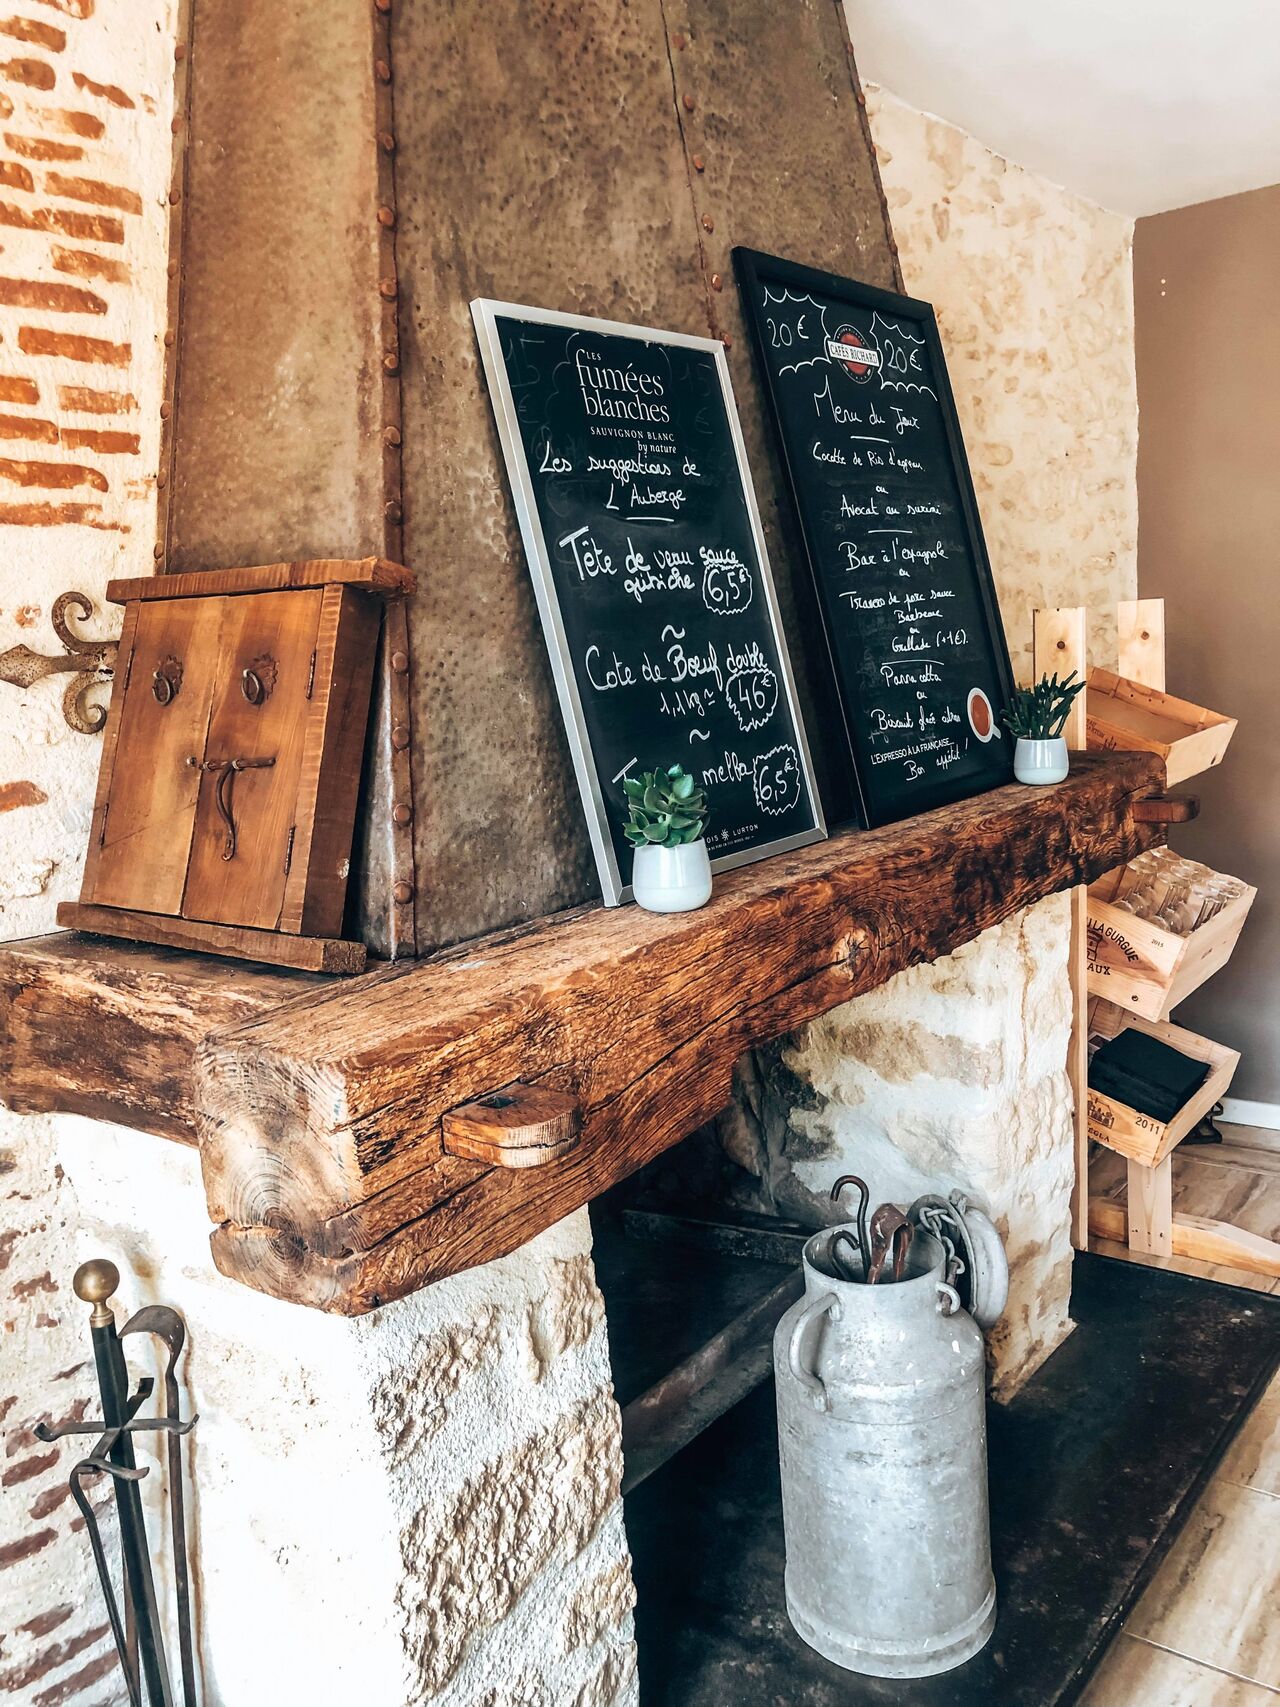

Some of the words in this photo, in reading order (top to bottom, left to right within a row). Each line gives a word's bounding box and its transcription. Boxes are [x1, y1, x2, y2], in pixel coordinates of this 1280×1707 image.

[586, 351, 602, 361] LES
[850, 348, 878, 364] RICHARD
[576, 348, 664, 396] fumées
[581, 387, 670, 423] blanches
[813, 374, 863, 424] Menu
[869, 402, 886, 425] du
[890, 406, 921, 435] Jour
[590, 426, 644, 439] SAUVIGNON
[647, 431, 676, 442] BLANC
[637, 440, 648, 454] by
[650, 443, 677, 454] nature
[539, 440, 573, 473] Les
[586, 452, 672, 487] suggestions
[682, 455, 701, 477] de
[852, 451, 863, 466] de
[867, 450, 884, 467] Ris
[630, 482, 687, 510] Auberge
[875, 485, 889, 495] ou
[840, 494, 880, 518] Avocat
[885, 506, 901, 515] au
[558, 525, 618, 581] Tête
[625, 537, 651, 574] de
[653, 550, 695, 569] veau
[699, 545, 740, 565] sauce
[838, 541, 877, 572] Bar
[898, 567, 911, 578] ou
[888, 591, 901, 606] de
[903, 592, 926, 612] porc
[929, 589, 955, 600] sauce
[909, 626, 921, 634] ou
[642, 651, 667, 683] de
[726, 640, 768, 674] double
[880, 665, 918, 688] Panna
[919, 664, 942, 683] cotta
[916, 690, 928, 700] ou
[870, 708, 914, 731] Biscuit
[870, 748, 907, 765] L'EXPRESSO
[907, 744, 914, 756] À
[912, 744, 921, 755] LA
[920, 737, 955, 752] FRANÇAISE
[903, 759, 926, 781] Bon
[706, 834, 719, 844] OIS
[732, 823, 759, 837] LURTON
[1087, 962, 1111, 976] AUX
[1087, 1126, 1110, 1143] EGLA
[1135, 1116, 1160, 1135] 2011
